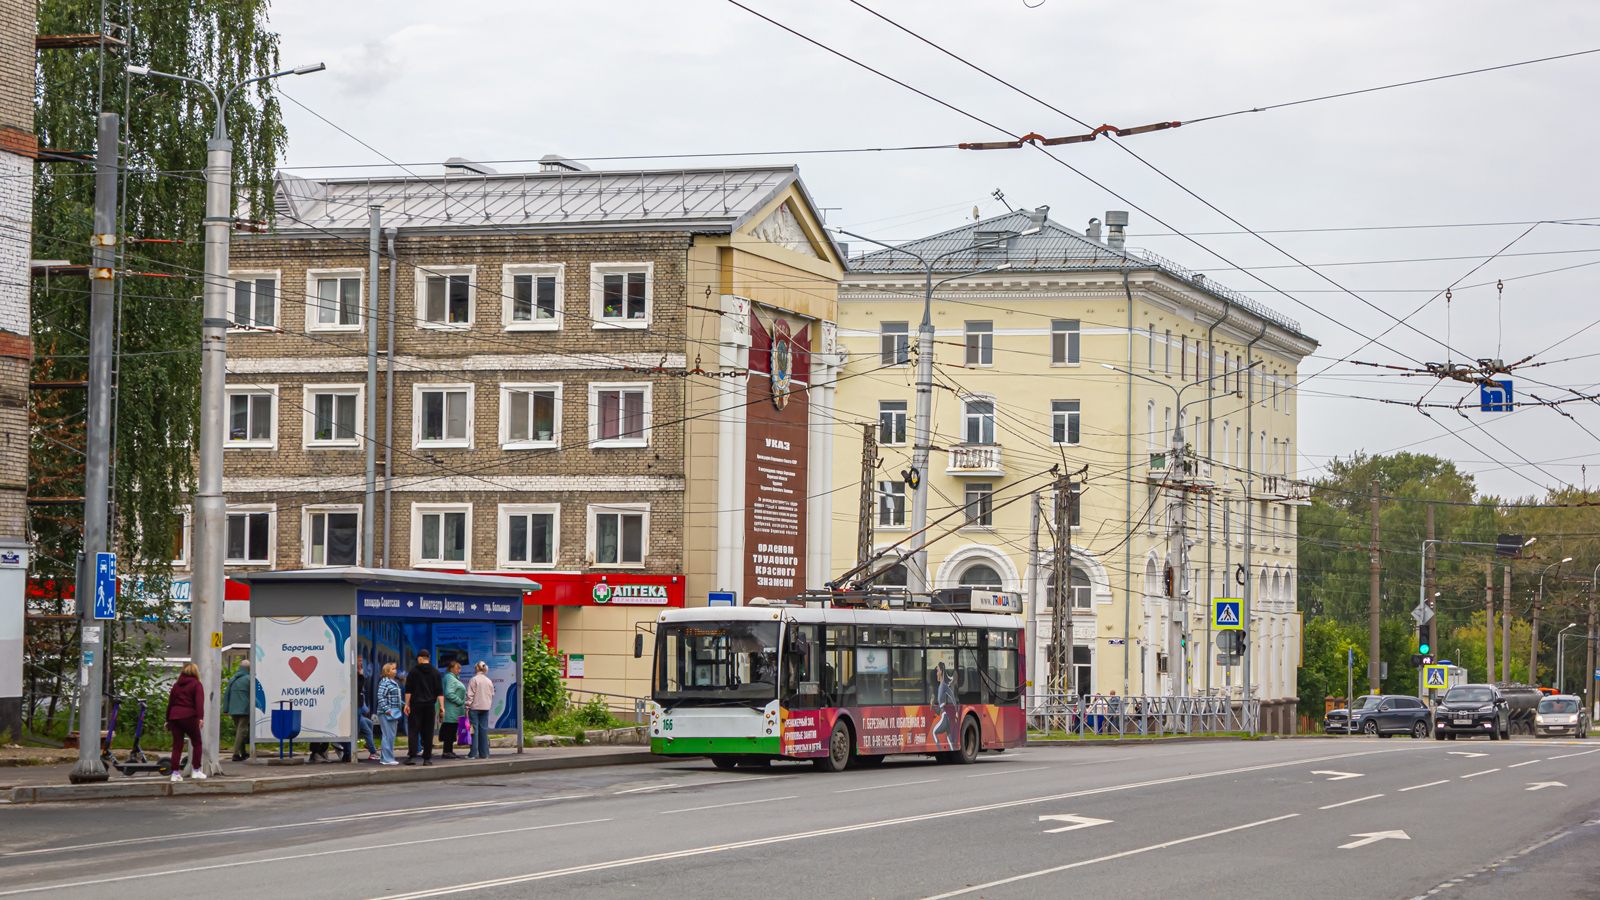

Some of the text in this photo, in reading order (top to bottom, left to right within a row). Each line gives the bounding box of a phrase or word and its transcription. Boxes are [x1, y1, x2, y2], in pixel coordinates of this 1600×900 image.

[765, 437, 791, 451] УКАЗ
[755, 565, 796, 577] Красного
[612, 584, 668, 598] АПТЕКА
[419, 596, 443, 614] Кинотеатр
[443, 598, 465, 615] Авангард
[492, 602, 511, 613] больница
[282, 643, 324, 653] Березники
[281, 685, 325, 696] ЛЮБИМЫЙ
[662, 719, 673, 730] 166
[867, 717, 890, 730] БЕРЕЗНИКИ,
[896, 715, 921, 729] ЮБИЛЕЙНАЯ,
